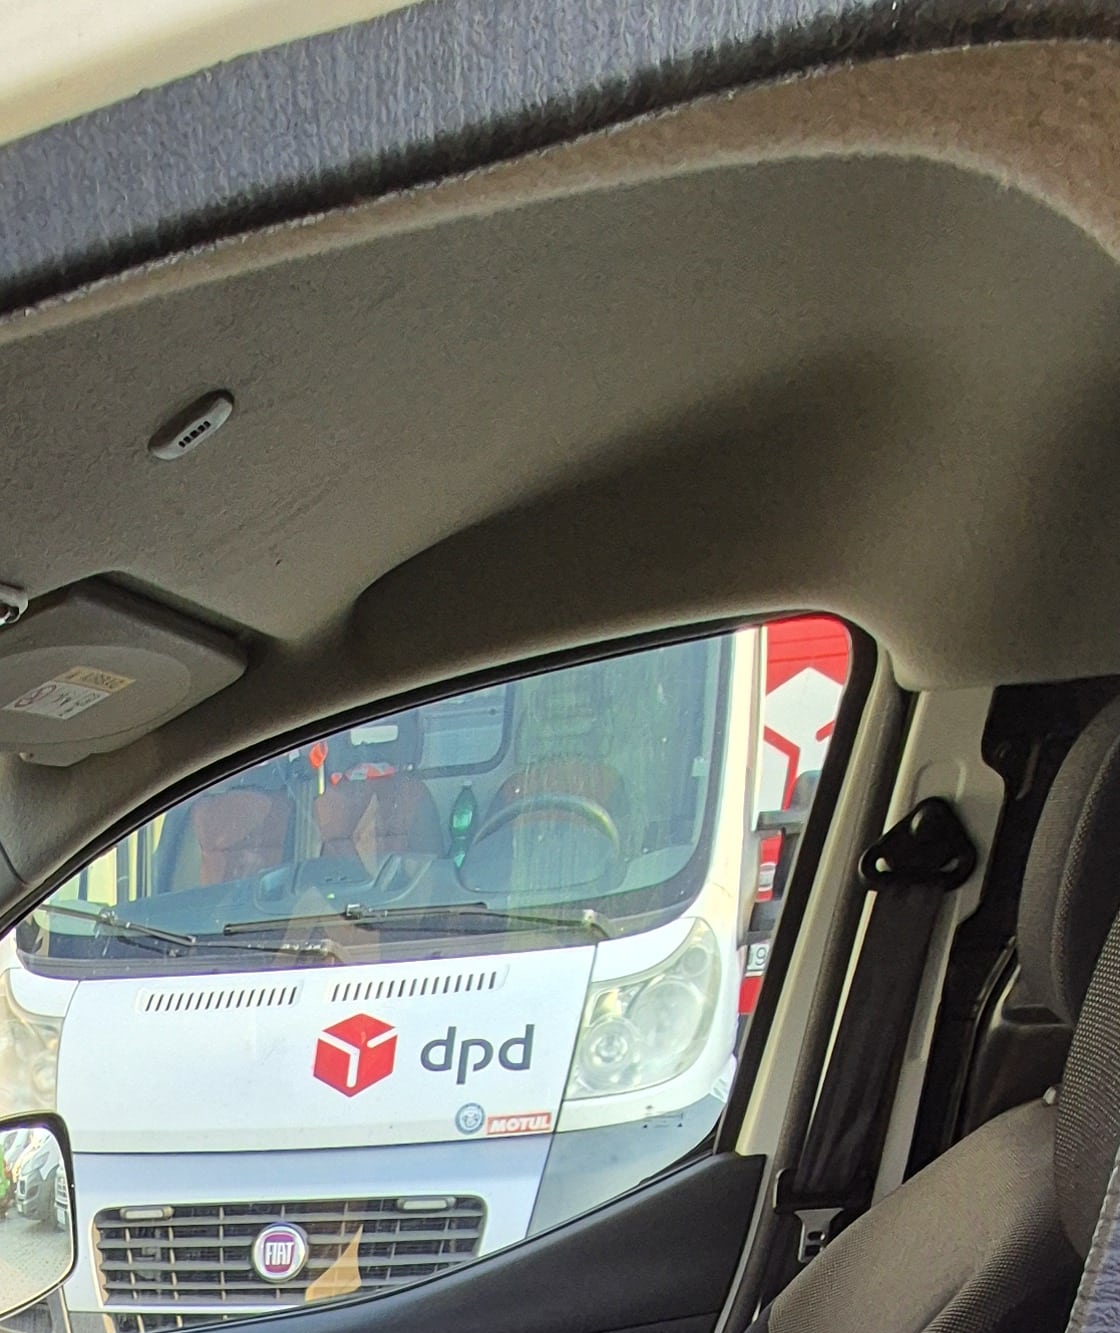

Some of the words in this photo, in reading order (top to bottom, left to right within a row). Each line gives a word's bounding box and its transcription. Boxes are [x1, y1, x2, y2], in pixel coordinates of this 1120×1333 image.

[420, 1023, 536, 1085] dpd
[489, 1115, 551, 1134] MOTUL
[264, 1240, 296, 1267] FIAT
